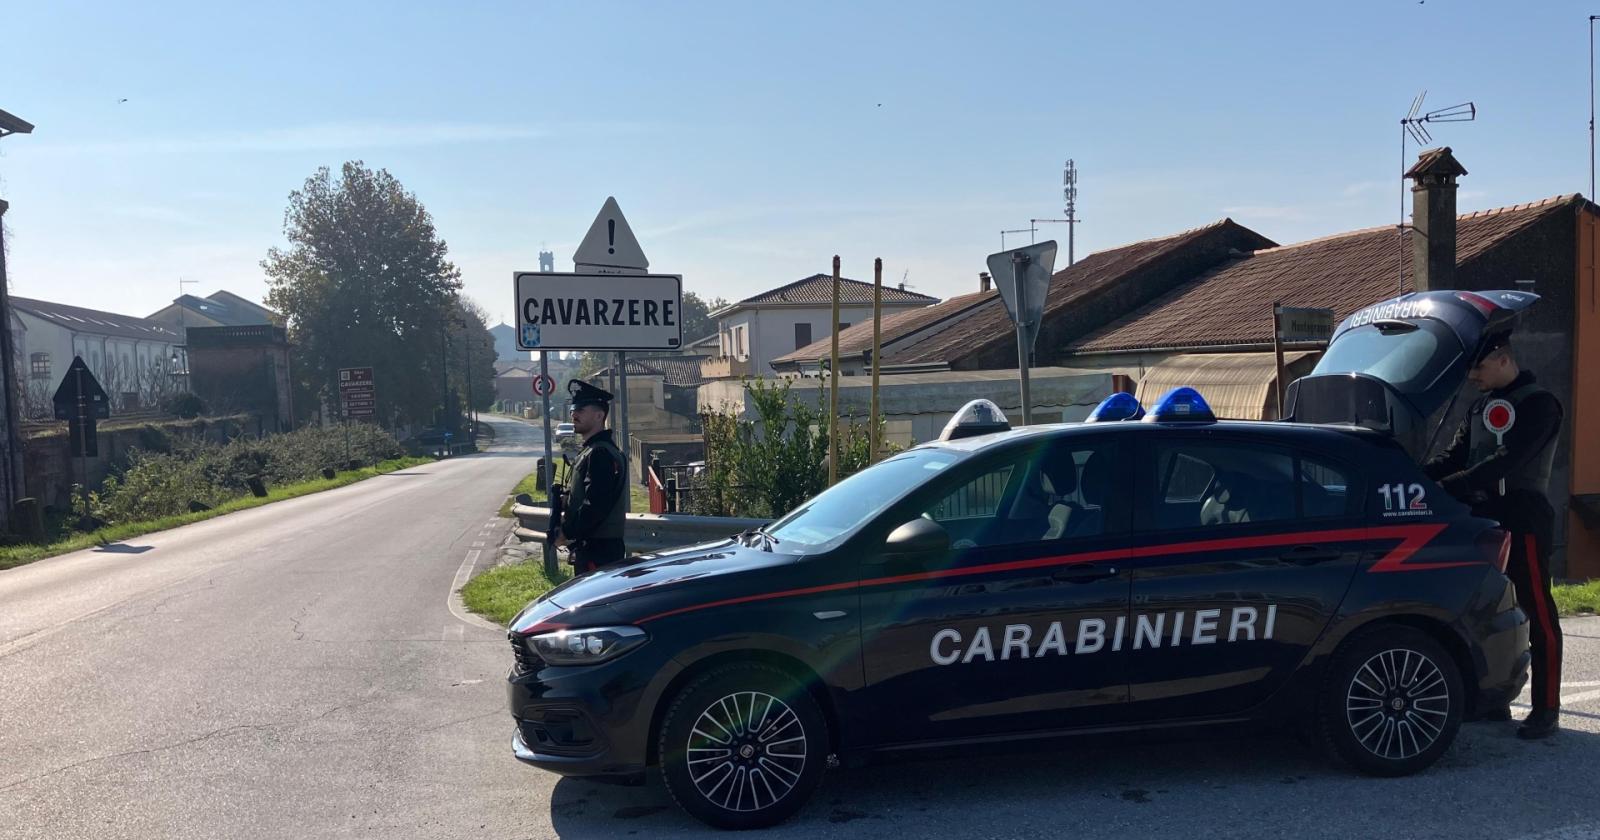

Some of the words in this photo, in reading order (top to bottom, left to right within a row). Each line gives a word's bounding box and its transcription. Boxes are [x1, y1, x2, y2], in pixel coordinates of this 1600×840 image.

[523, 297, 675, 326] CAVARZERE
[1377, 483, 1427, 510] 112
[929, 604, 1277, 666] CARABINIERI
